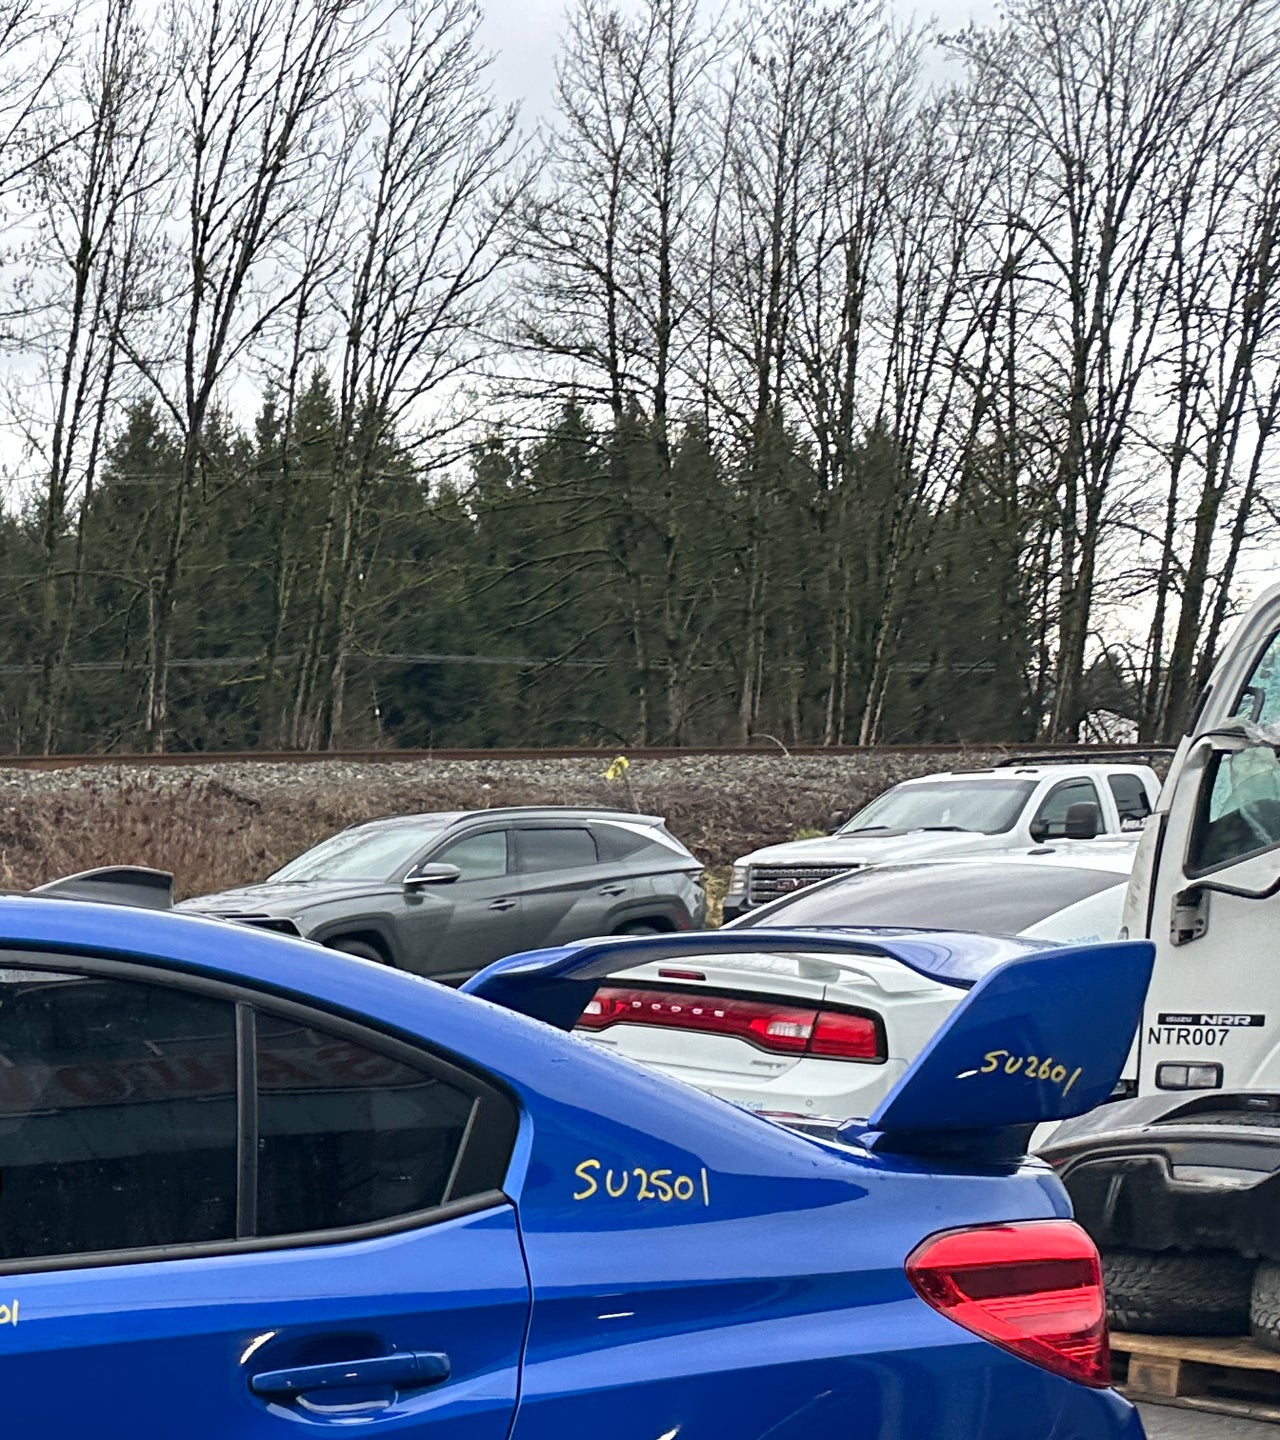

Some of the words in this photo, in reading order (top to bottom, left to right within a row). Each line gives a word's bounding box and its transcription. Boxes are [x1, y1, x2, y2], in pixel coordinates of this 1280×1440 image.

[1199, 1015, 1252, 1026] NRR
[1147, 1026, 1230, 1047] NTR007
[979, 1049, 1084, 1097] SU2601
